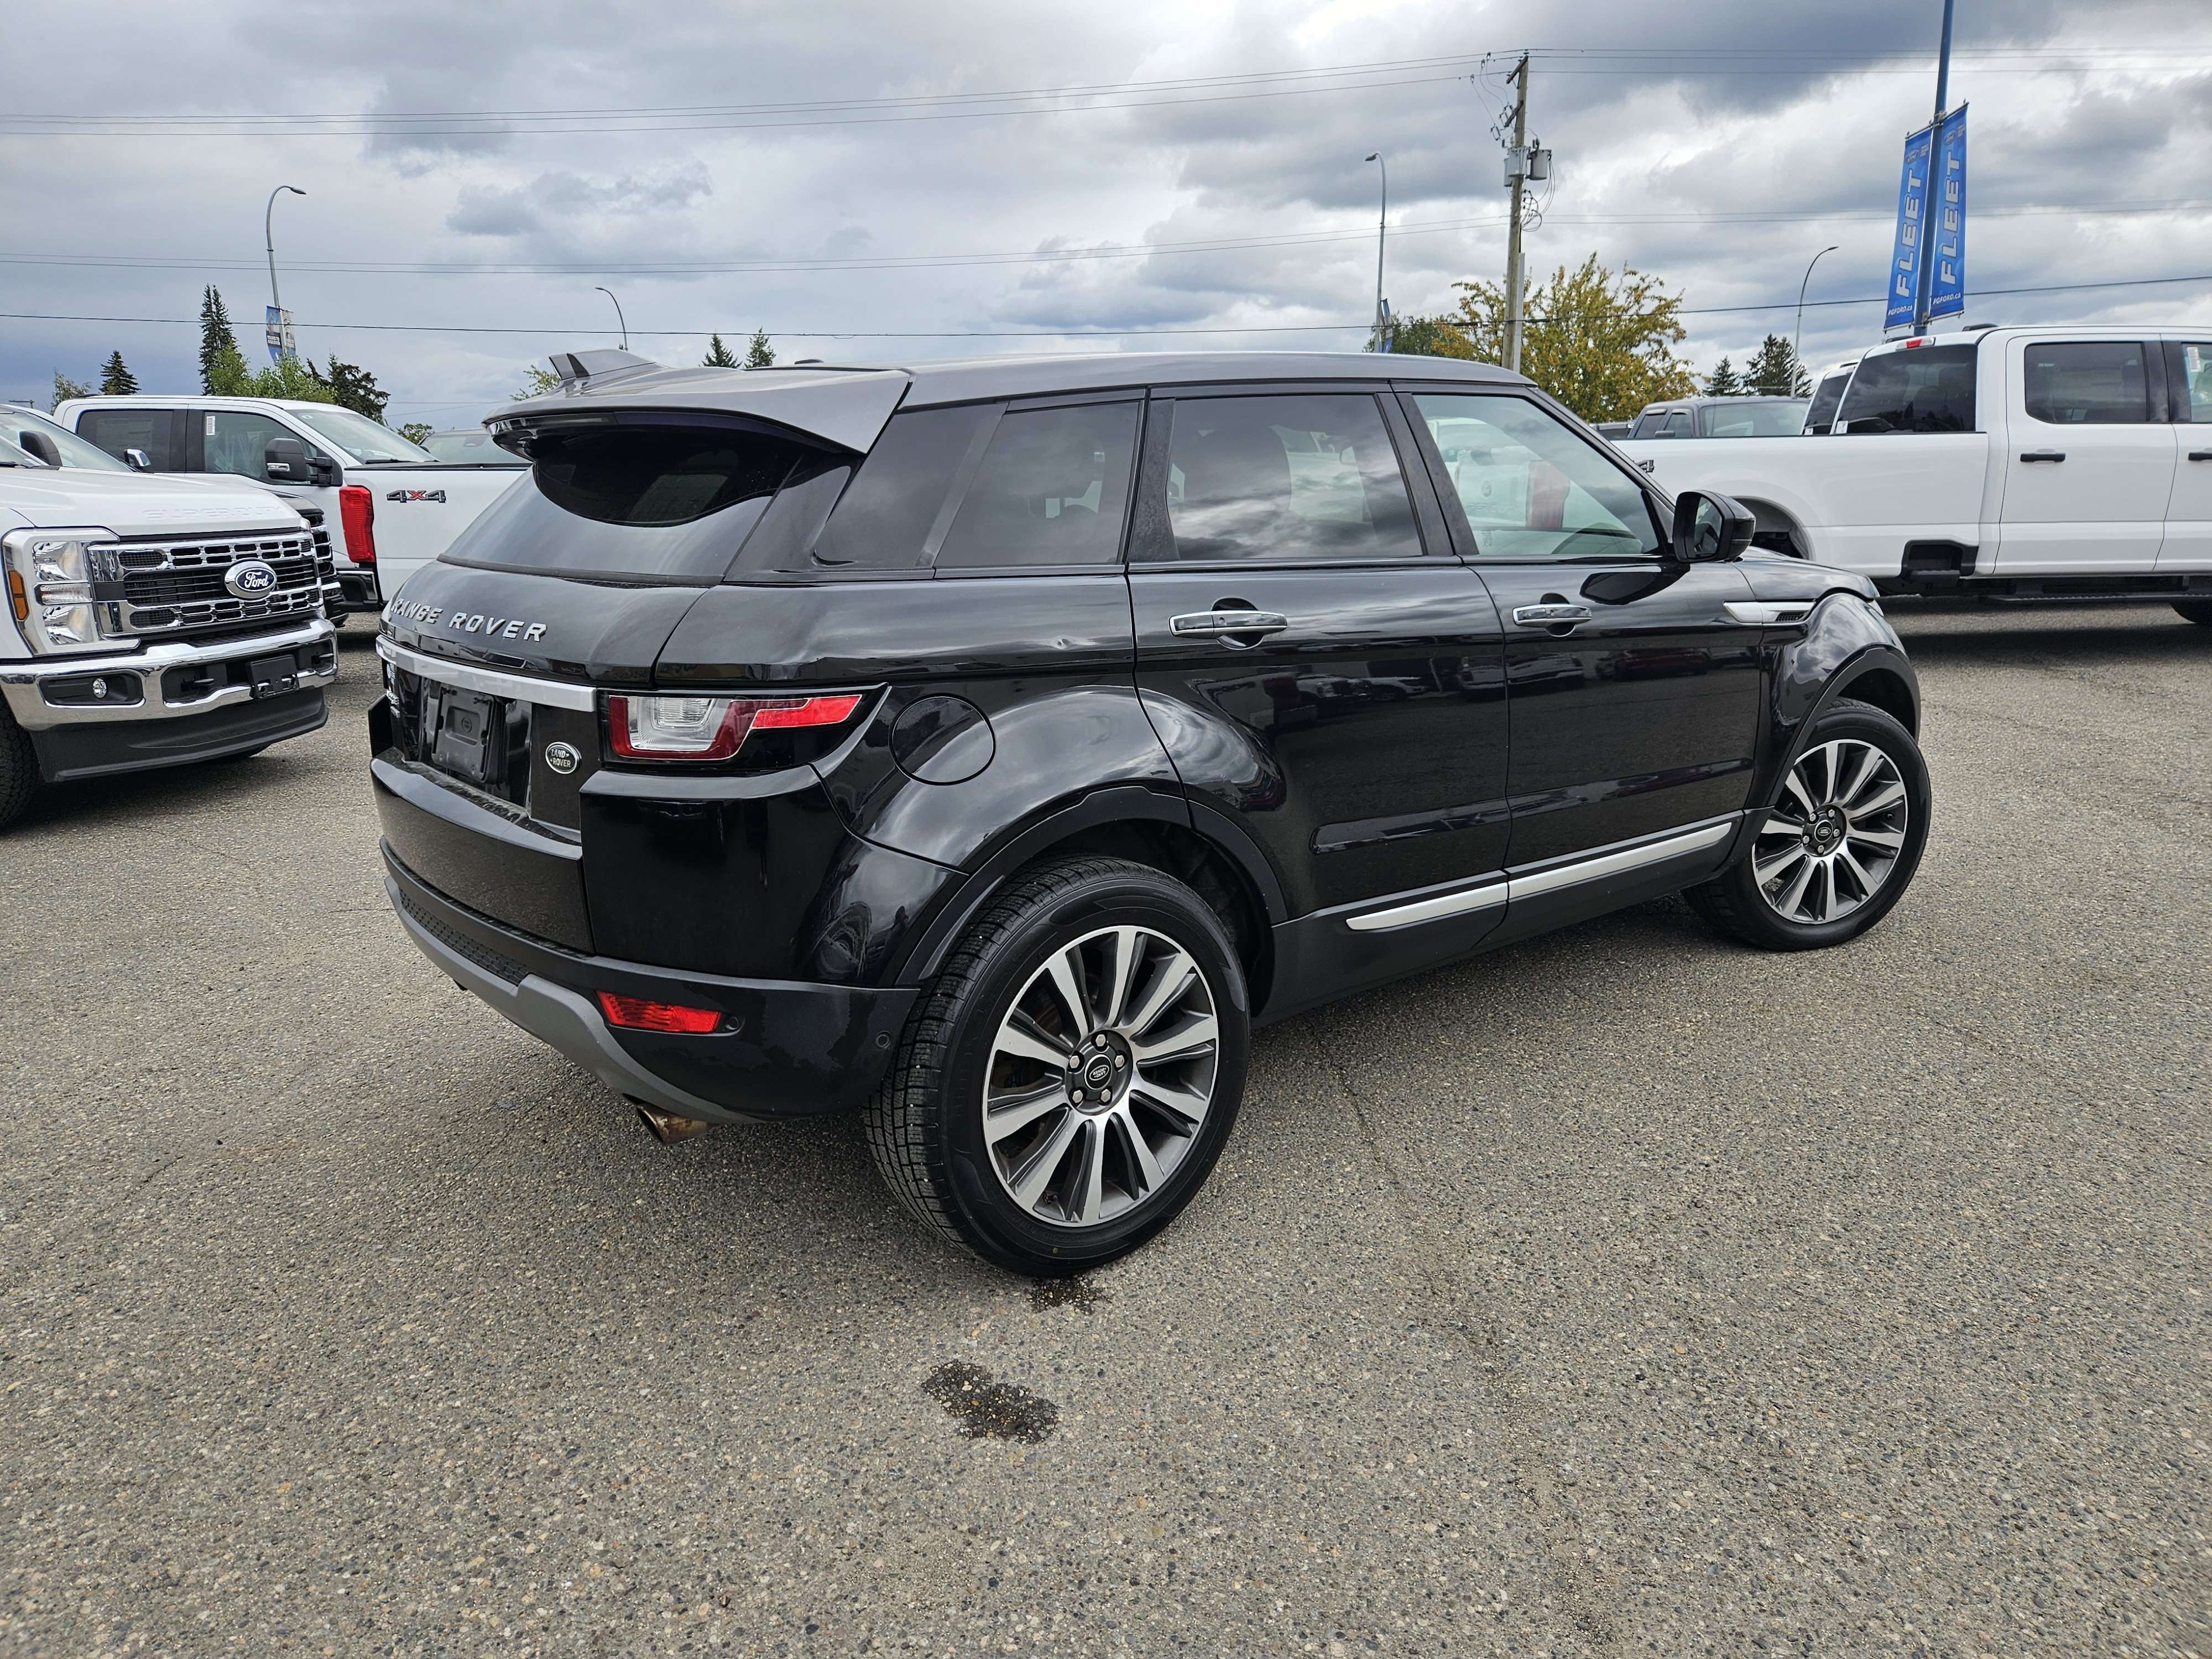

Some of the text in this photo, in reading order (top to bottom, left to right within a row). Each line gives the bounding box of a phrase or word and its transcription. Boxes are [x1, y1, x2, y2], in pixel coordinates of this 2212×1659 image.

[1940, 150, 1959, 285] FLEET
[1896, 168, 1921, 298] FLEET
[1932, 292, 1961, 305] PGFORD.ca
[1887, 304, 1913, 316] PGFORD.ca
[244, 571, 269, 588] Ford
[390, 598, 547, 642] RANGE ROVER
[551, 748, 566, 759] LAND
[553, 757, 571, 768] ROVER
